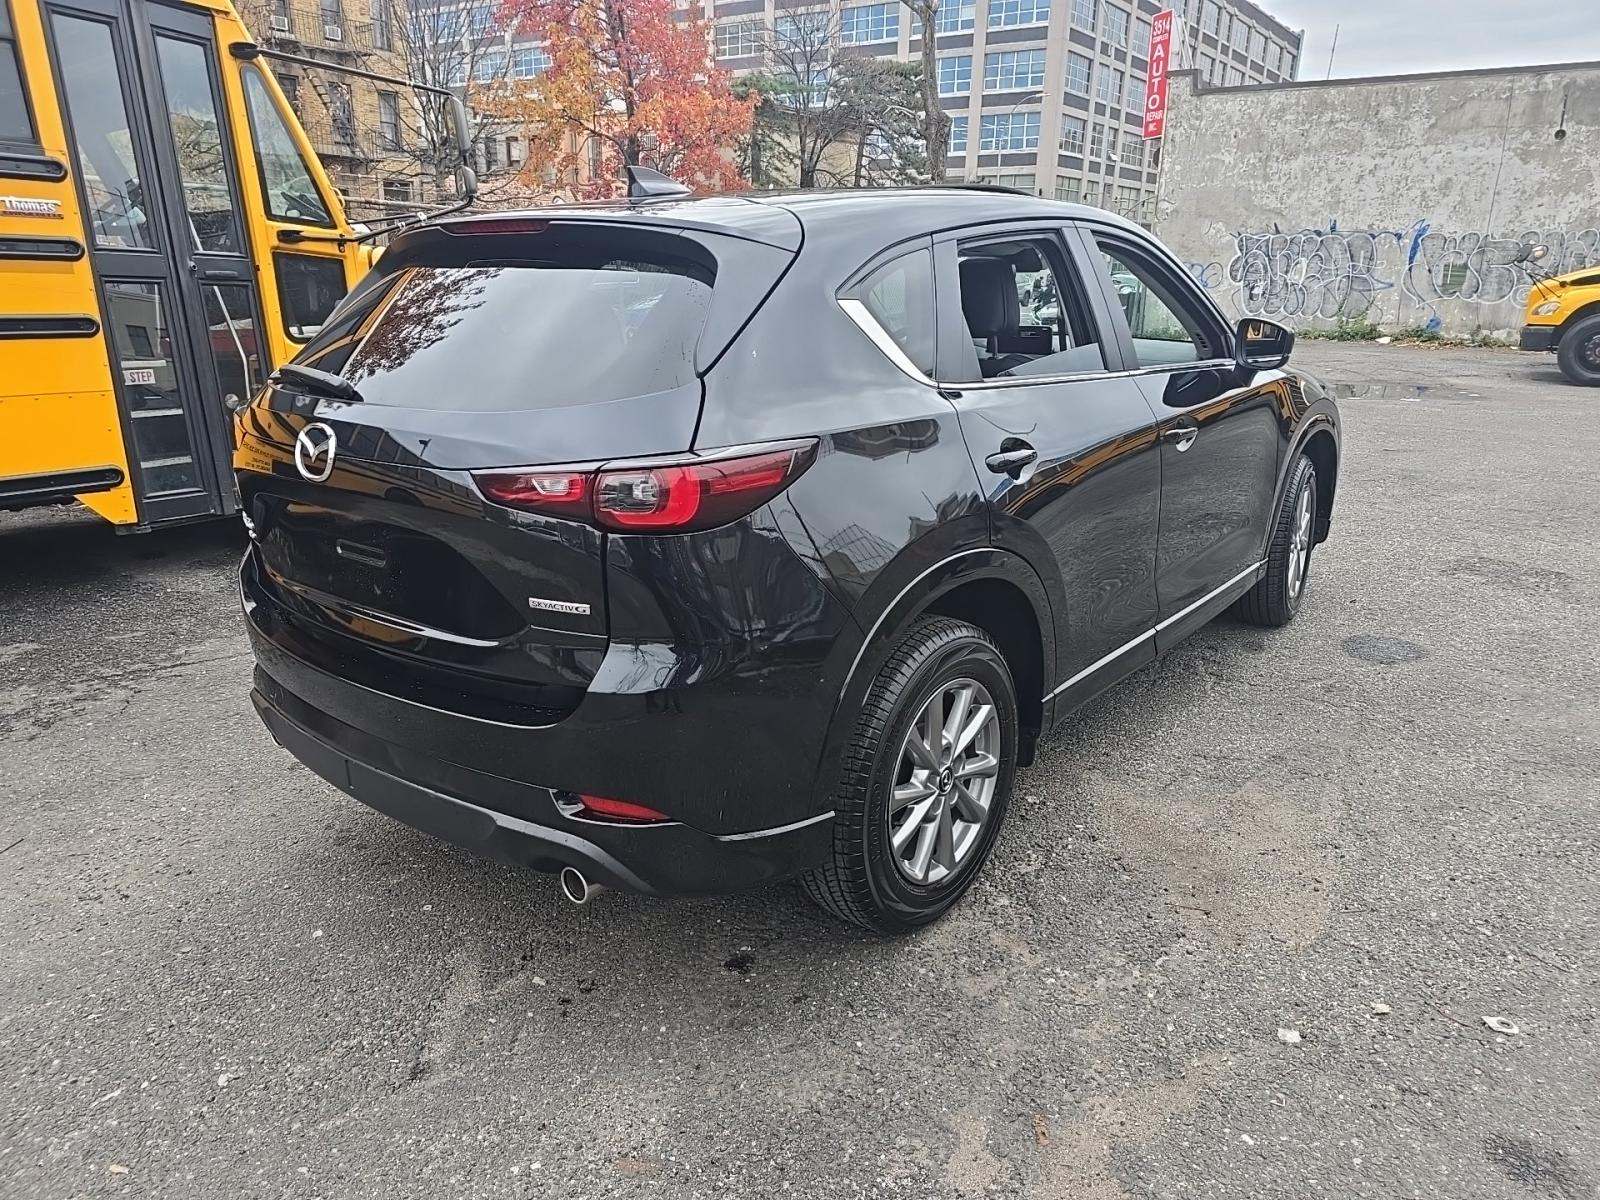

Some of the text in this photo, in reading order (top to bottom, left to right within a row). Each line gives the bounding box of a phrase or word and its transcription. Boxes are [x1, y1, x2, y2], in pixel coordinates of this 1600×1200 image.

[1153, 17, 1170, 36] 3514
[1148, 43, 1165, 110] AUTO
[1146, 110, 1163, 121] REPAIR
[2, 197, 56, 213] Thomas
[130, 371, 152, 383] STEP
